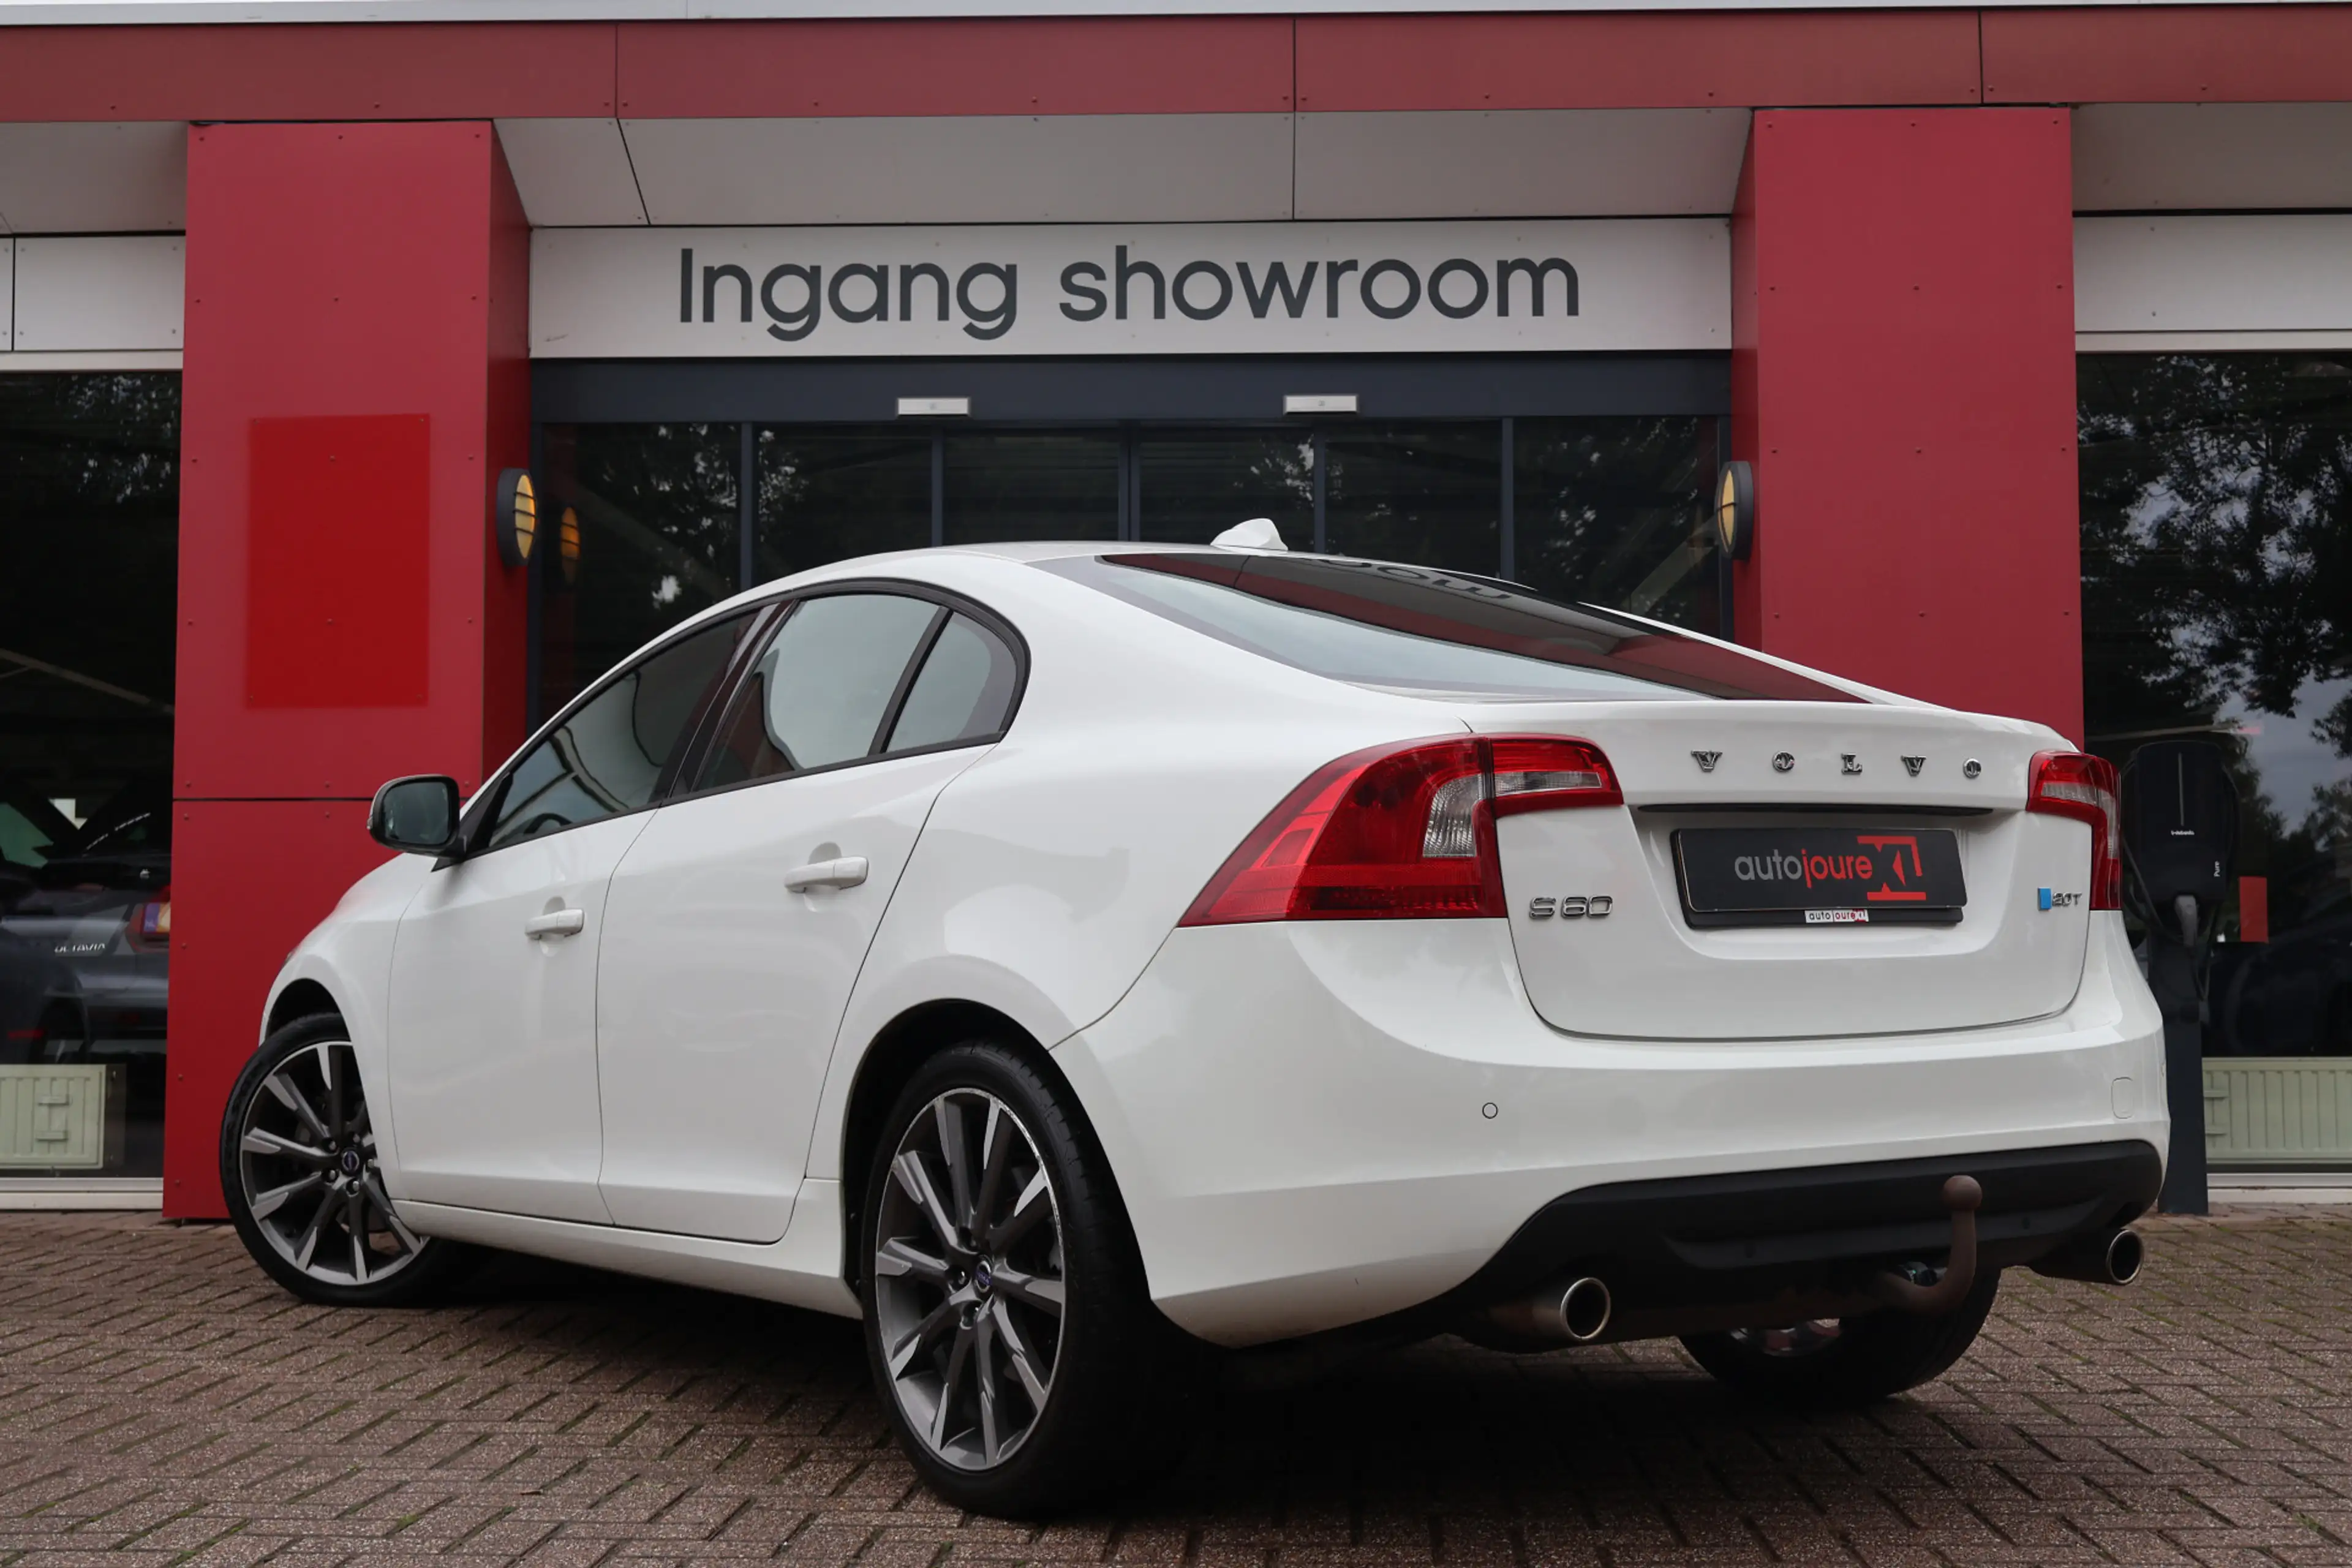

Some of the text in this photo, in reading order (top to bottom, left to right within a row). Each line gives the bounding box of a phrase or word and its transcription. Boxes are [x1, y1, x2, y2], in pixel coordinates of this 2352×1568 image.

[680, 245, 1578, 341] Ingang showroom
[1691, 750, 1981, 780] VOLVO
[1734, 848, 1873, 889] autojoure
[1529, 895, 1613, 919] S60
